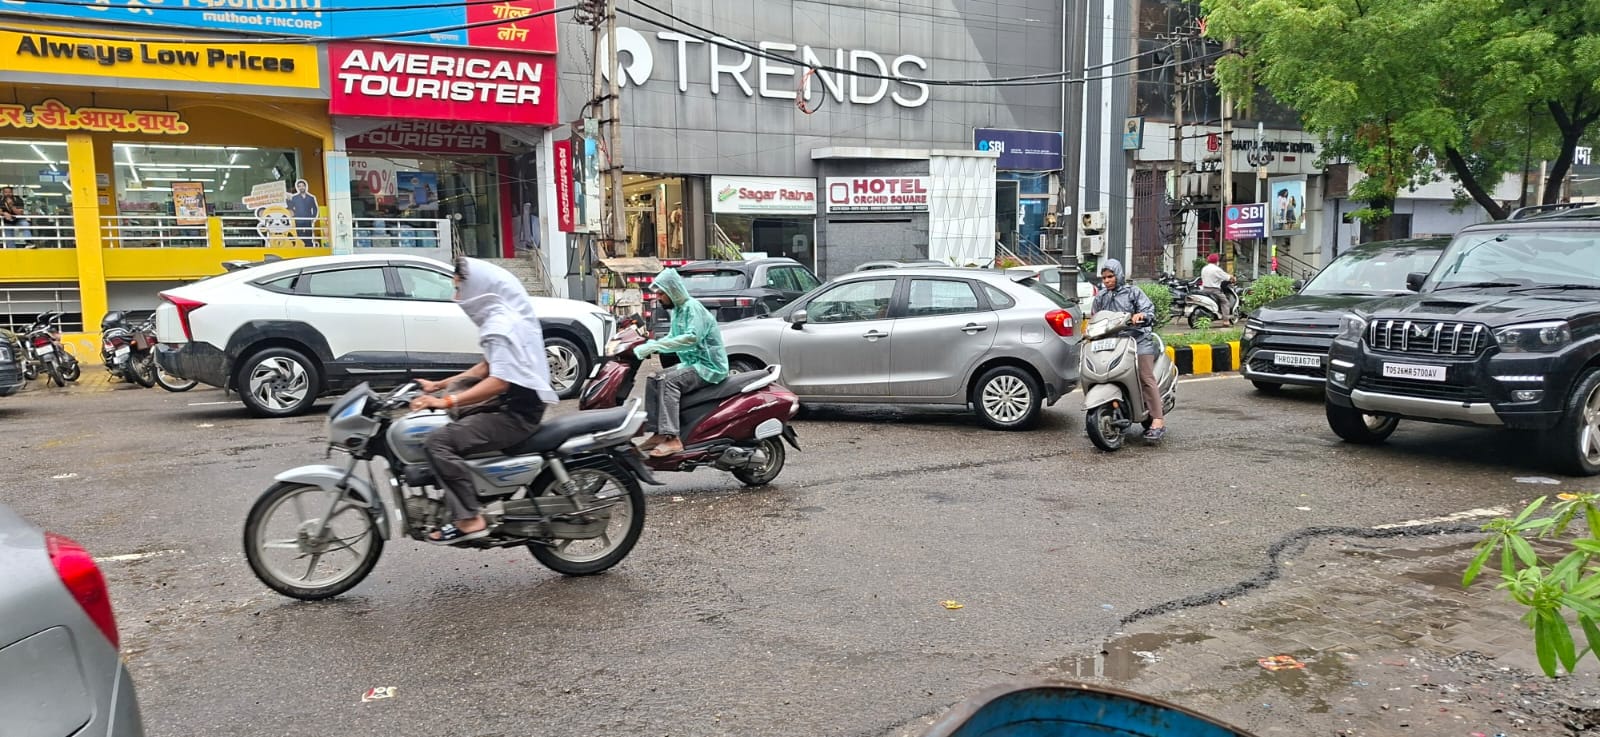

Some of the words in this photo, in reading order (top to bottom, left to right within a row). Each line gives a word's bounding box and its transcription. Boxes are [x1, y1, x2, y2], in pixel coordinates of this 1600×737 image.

[203, 11, 263, 25] muthoot
[265, 16, 323, 30] FINCORP
[497, 22, 529, 42] लोन
[16, 35, 134, 65] Always
[140, 43, 199, 66] Low
[206, 47, 295, 72] Prices
[341, 49, 543, 82] AMERICAN
[656, 31, 930, 108] TRENDS
[338, 73, 541, 105] TOURISTER
[988, 140, 1005, 153] SBI
[738, 187, 777, 202] Sagar
[779, 188, 814, 202] Ratna
[853, 179, 927, 194] HOTEL
[853, 195, 888, 204] ORCHID
[890, 195, 927, 204] SQUARE
[1241, 205, 1263, 220] SBI
